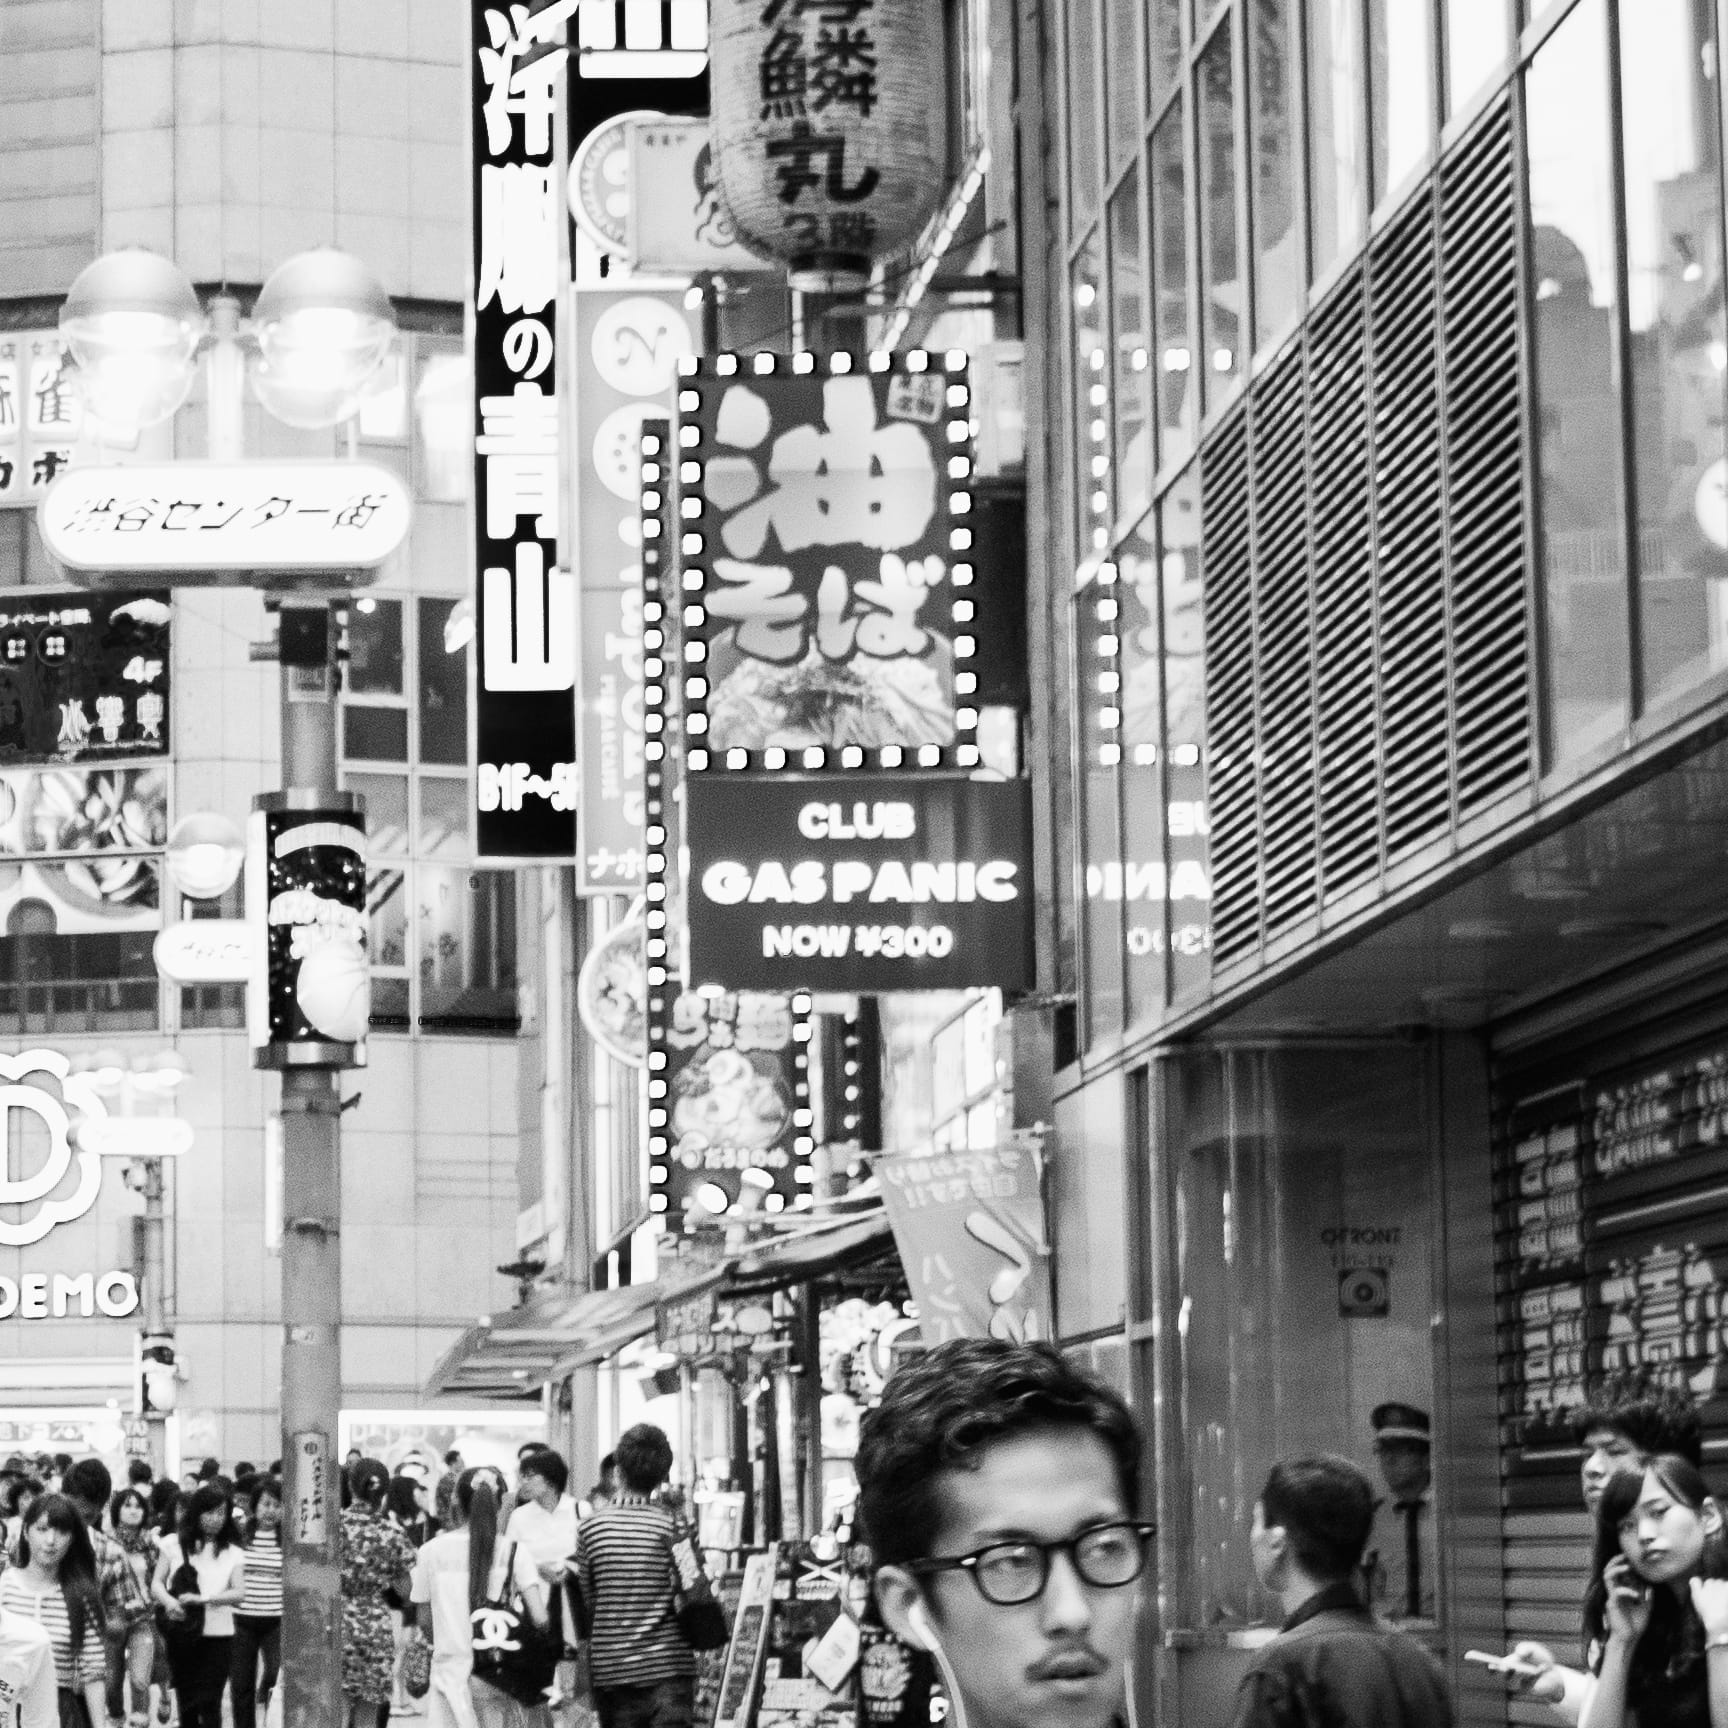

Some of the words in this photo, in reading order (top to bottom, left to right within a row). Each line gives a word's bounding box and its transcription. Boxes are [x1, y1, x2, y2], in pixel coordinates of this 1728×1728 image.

[798, 802, 917, 840] CLUB
[701, 860, 830, 904] GAS
[830, 860, 1020, 904] PANIC
[762, 924, 853, 959] NOW
[854, 924, 954, 959] ¥300
